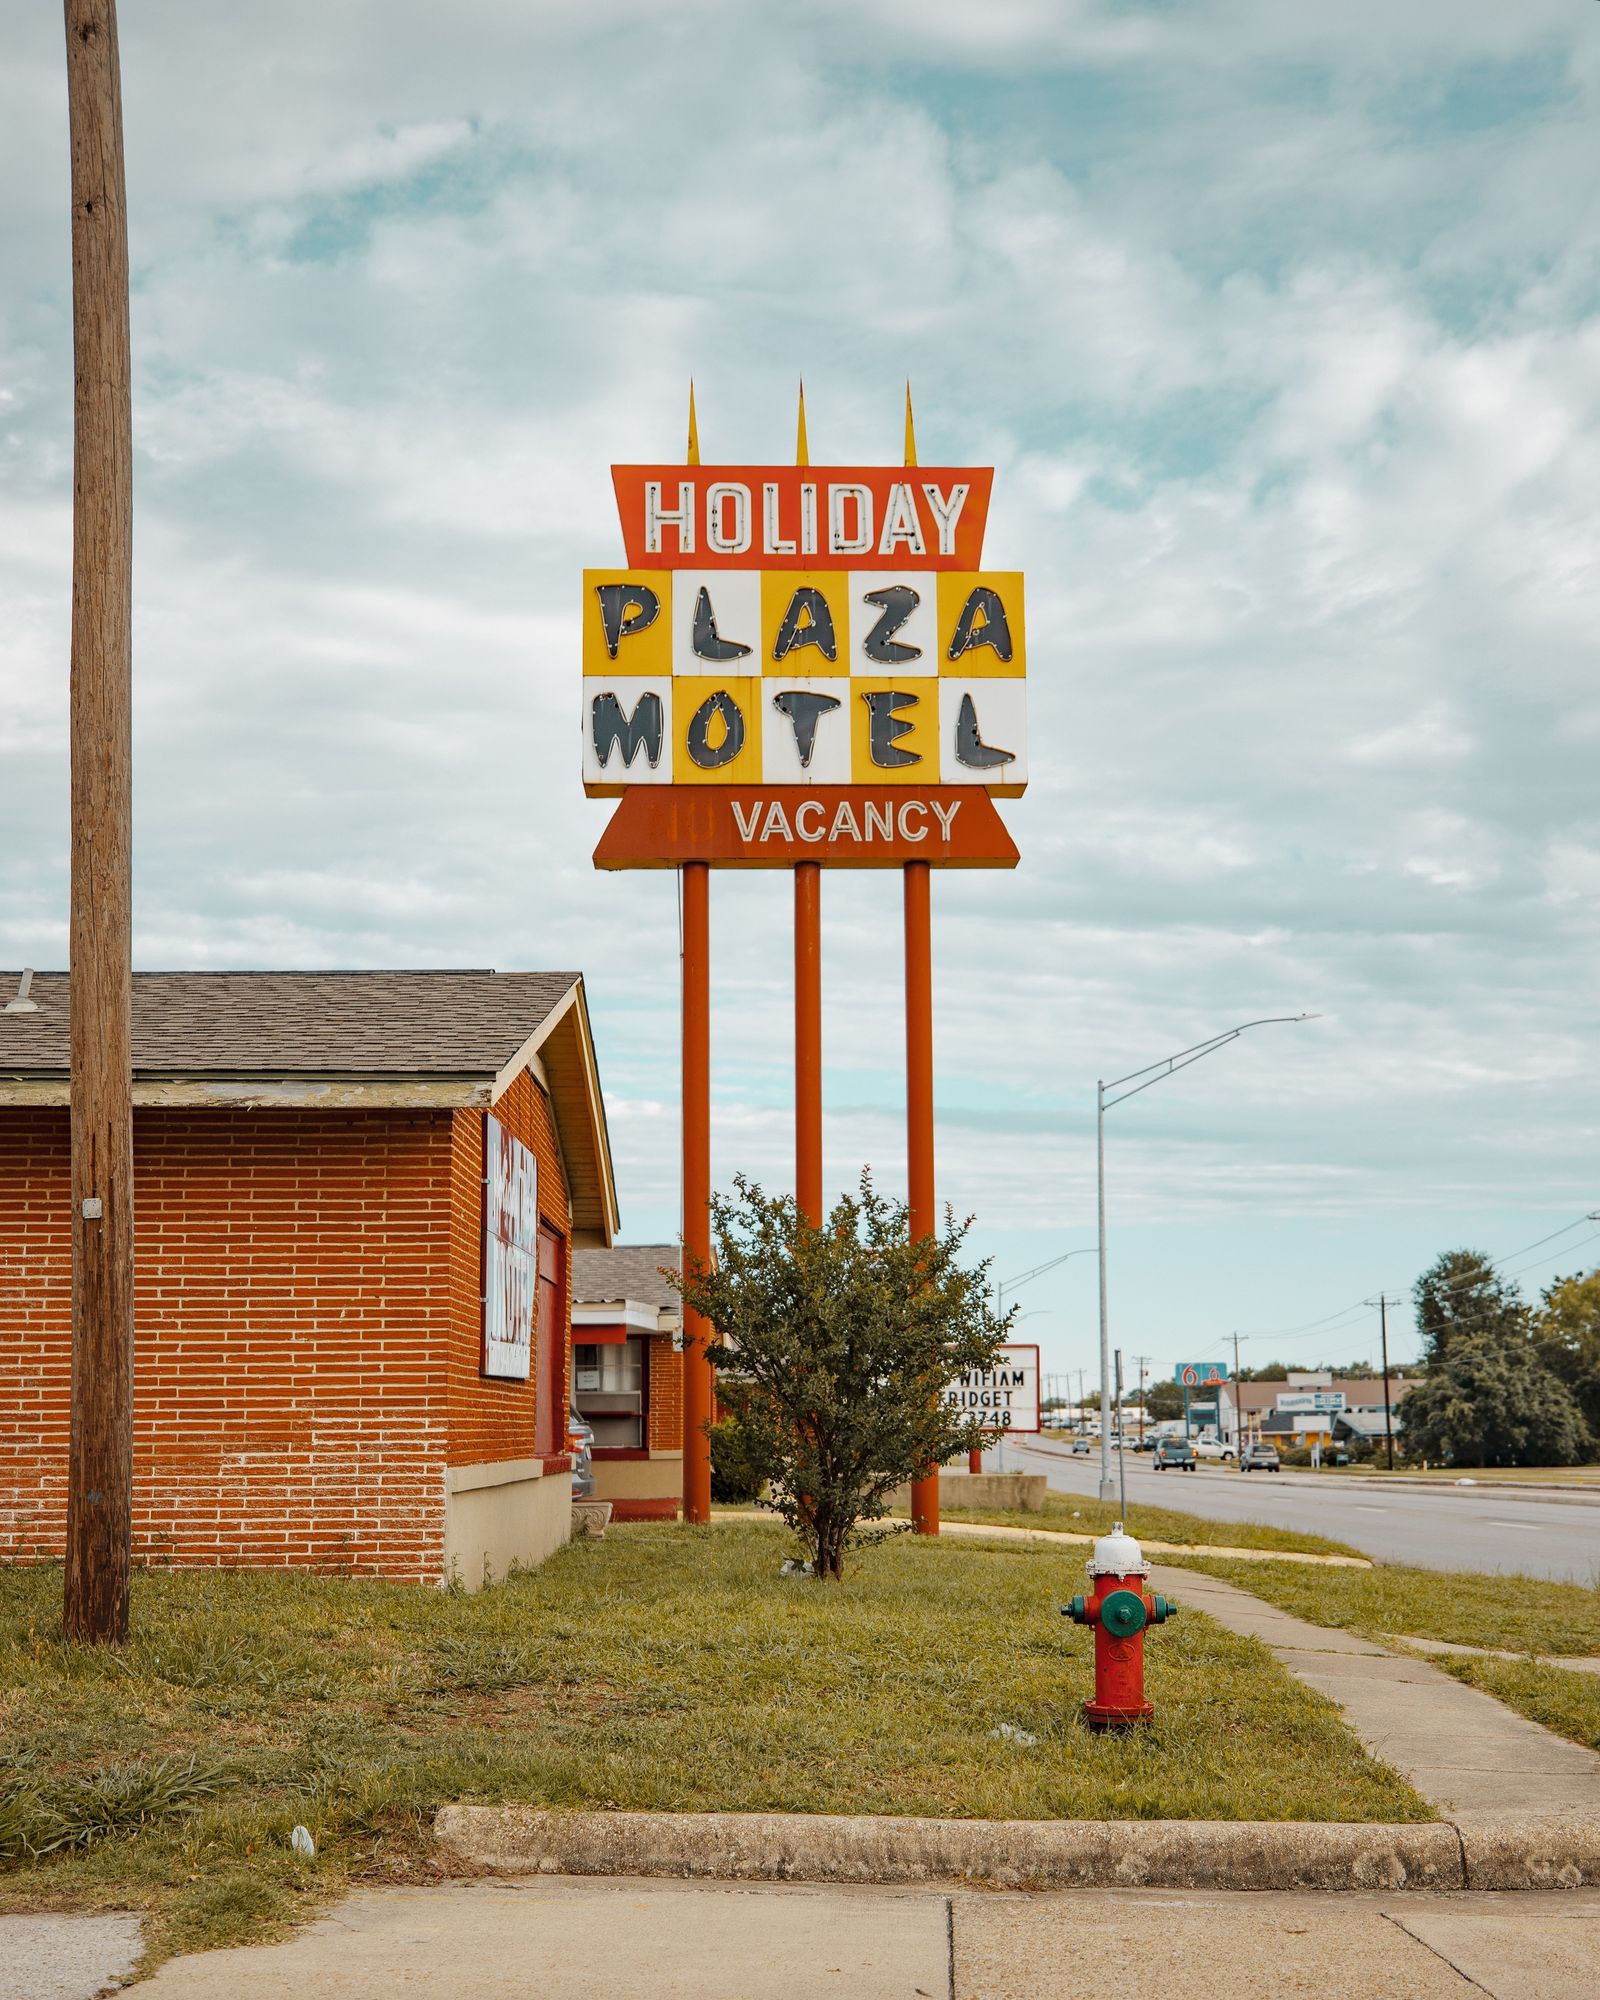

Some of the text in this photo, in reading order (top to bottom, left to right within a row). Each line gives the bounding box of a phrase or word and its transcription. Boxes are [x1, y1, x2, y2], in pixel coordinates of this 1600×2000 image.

[645, 481, 970, 555] HOLIDAY
[595, 584, 1013, 664] PLAZA
[591, 690, 1016, 769] MOTEL
[731, 801, 962, 842] VACANCY
[943, 1391, 1013, 1406] RIDGET
[1182, 1364, 1198, 1386] 6
